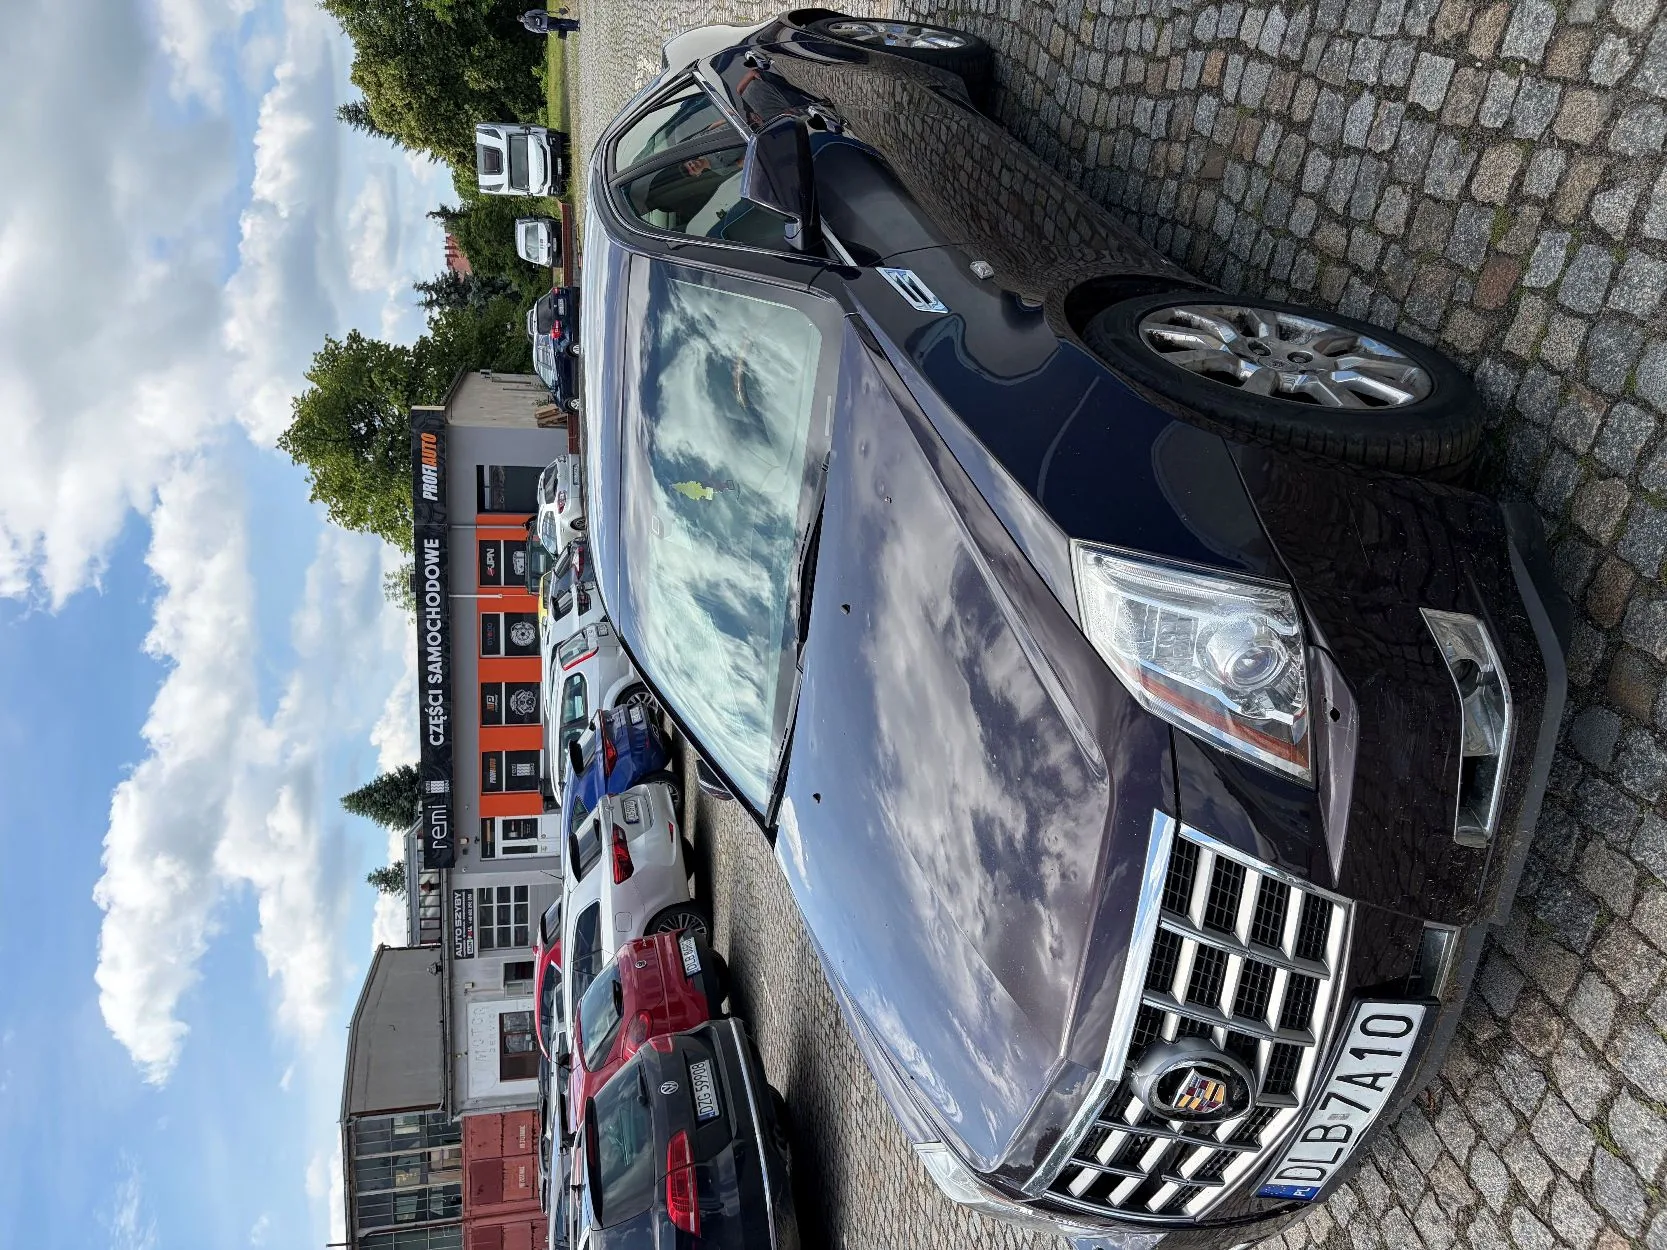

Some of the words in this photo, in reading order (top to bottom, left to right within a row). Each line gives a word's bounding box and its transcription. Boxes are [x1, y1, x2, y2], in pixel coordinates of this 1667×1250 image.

[420, 432, 438, 501] PROFIAUTO
[486, 548, 494, 568] JPN
[424, 538, 442, 684] SAMOCHODOWE
[424, 690, 447, 746] CZĘŚCI
[428, 804, 447, 849] remi
[454, 892, 462, 927] SZYBY
[692, 1063, 709, 1092] 59908
[697, 1093, 713, 1114] DZG
[1274, 1124, 1353, 1182] DLB
[1318, 1014, 1413, 1113] 7A10
[1293, 1187, 1311, 1196] PL
